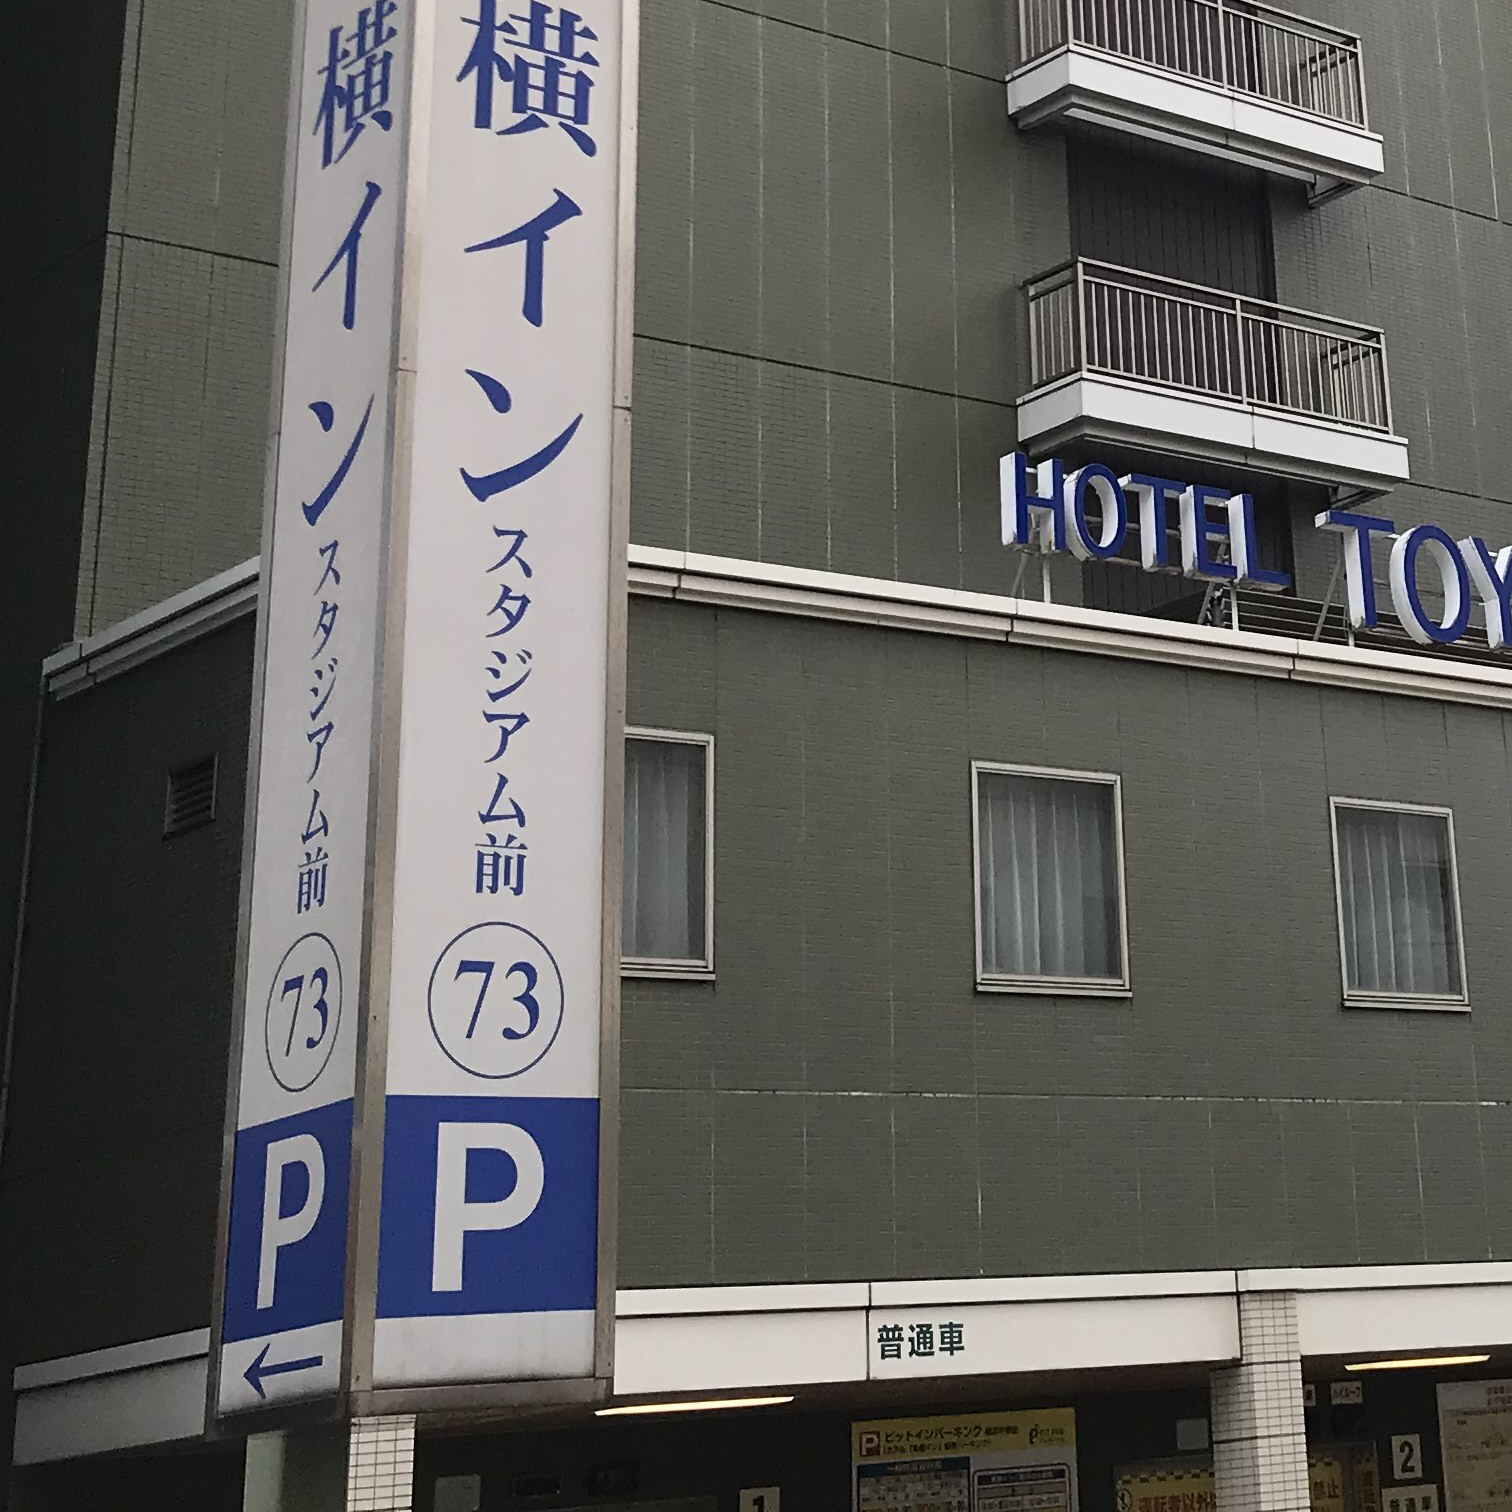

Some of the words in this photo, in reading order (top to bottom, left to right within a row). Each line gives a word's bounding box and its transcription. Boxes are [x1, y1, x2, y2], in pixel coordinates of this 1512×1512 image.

[1000, 451, 1290, 591] HOTEL
[297, 540, 341, 915] スタジアム前
[475, 525, 533, 896] スタジアム前
[280, 966, 329, 1058] 73
[453, 959, 541, 1041] 73
[256, 1133, 326, 1310] P
[431, 1121, 545, 1292] P
[877, 1321, 966, 1360] 普通車
[1399, 1440, 1416, 1474] 2
